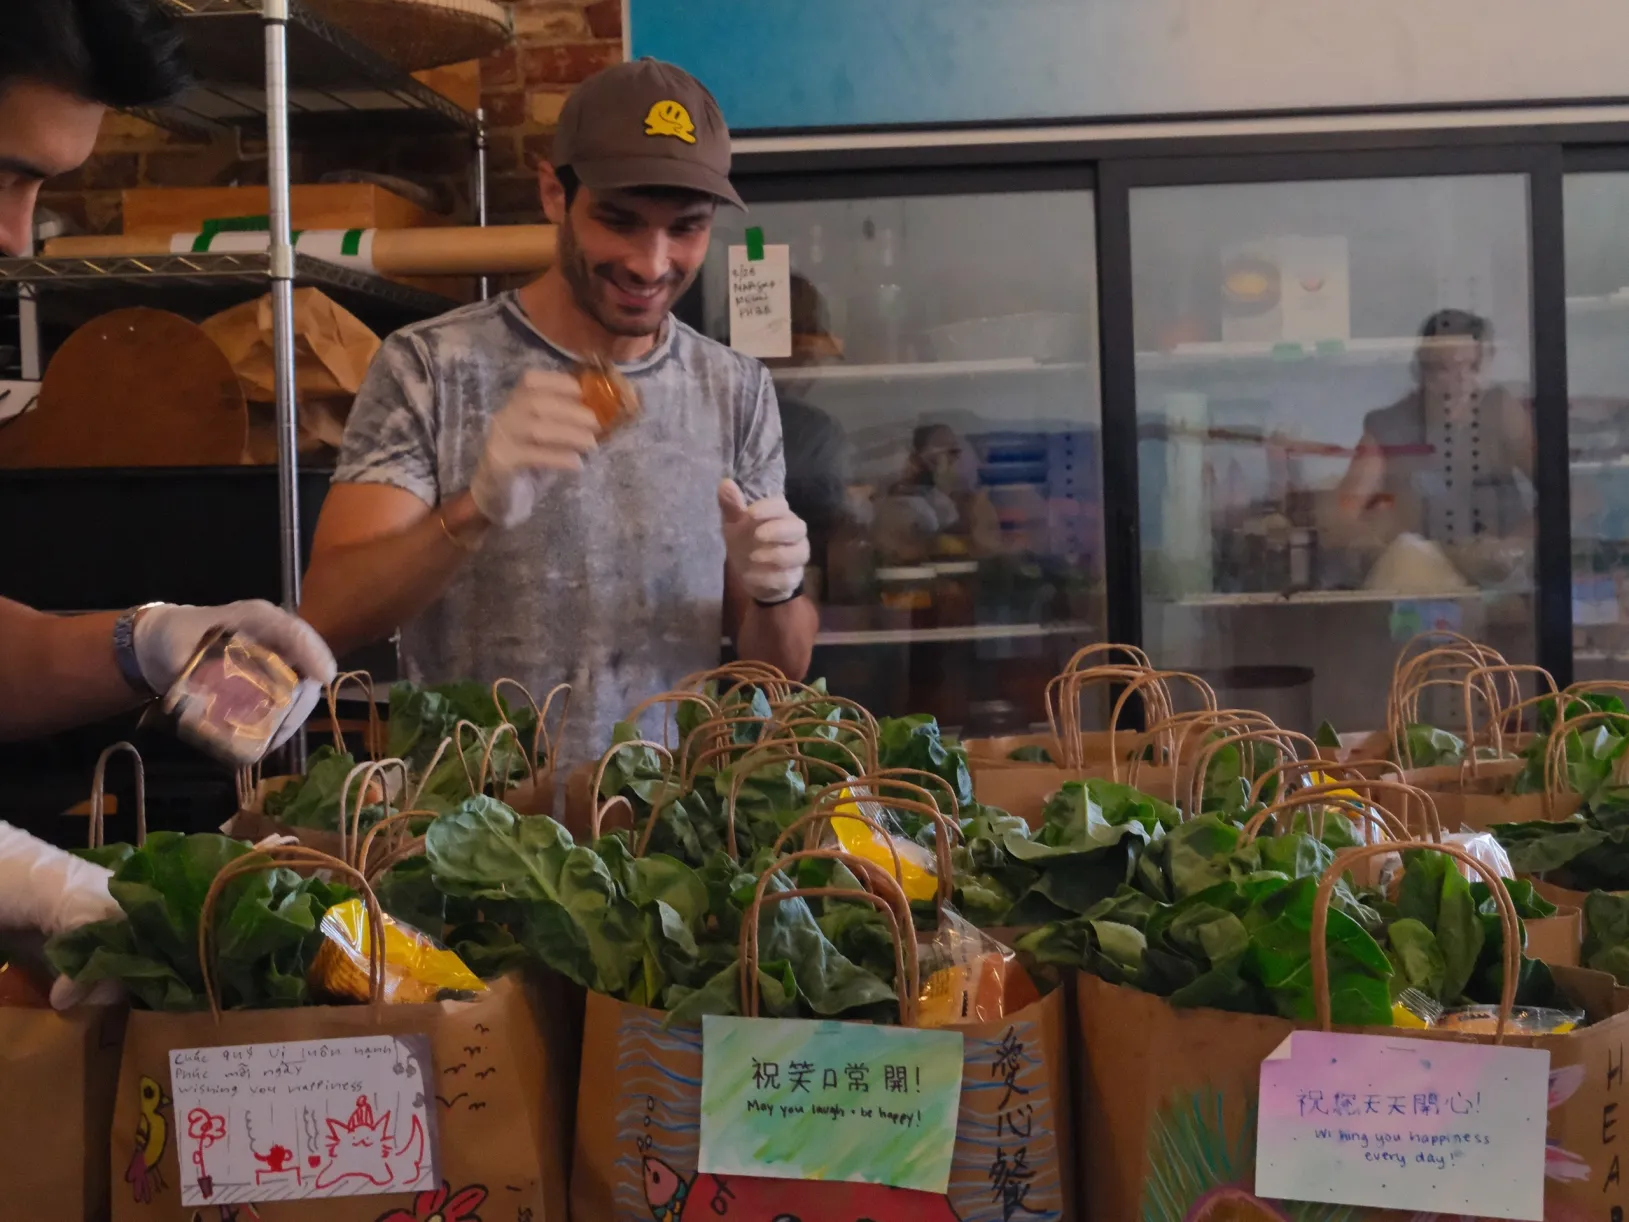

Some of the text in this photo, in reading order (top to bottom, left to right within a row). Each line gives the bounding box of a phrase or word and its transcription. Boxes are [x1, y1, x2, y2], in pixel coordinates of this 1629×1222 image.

[746, 1099, 774, 1116] May
[779, 1104, 805, 1119] you
[811, 1103, 846, 1121] laugh
[860, 1106, 874, 1119] be
[878, 1107, 922, 1128] happy!
[1374, 1132, 1402, 1149] you
[1409, 1130, 1491, 1146] happiness
[1364, 1150, 1456, 1170] every day!
